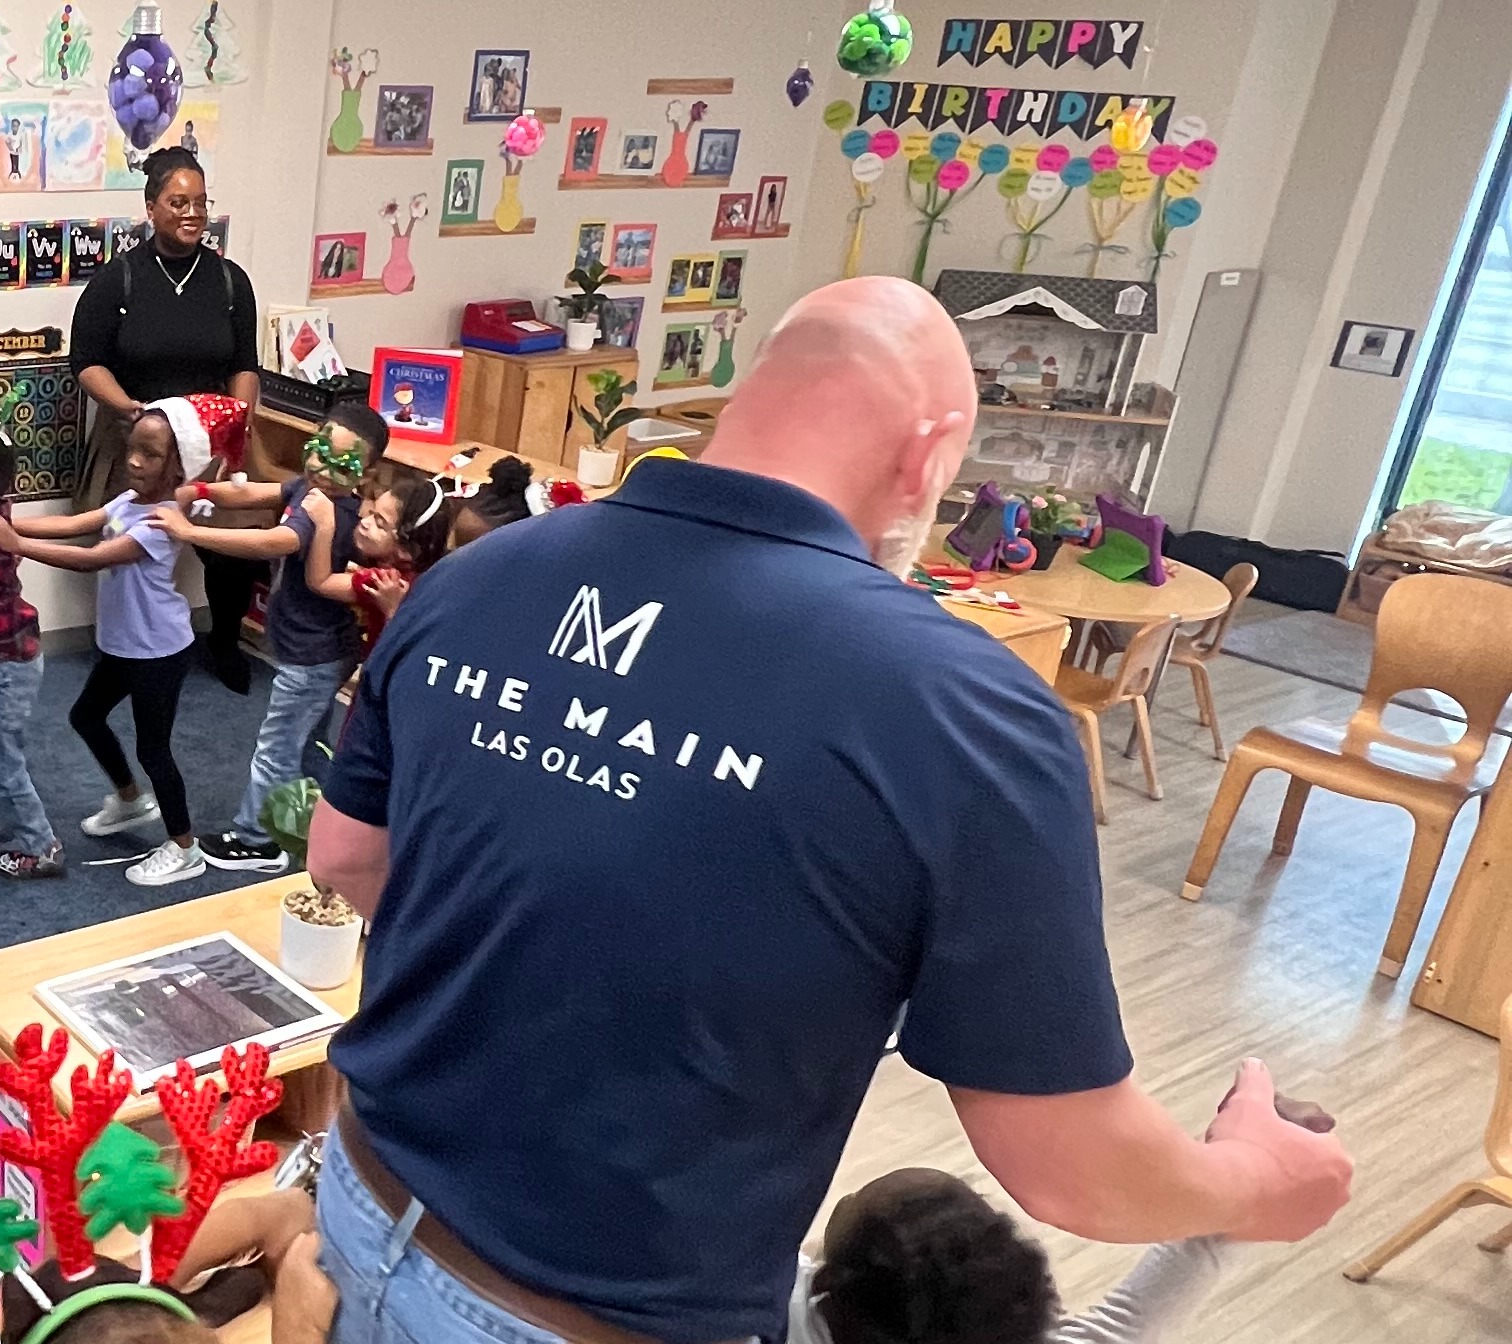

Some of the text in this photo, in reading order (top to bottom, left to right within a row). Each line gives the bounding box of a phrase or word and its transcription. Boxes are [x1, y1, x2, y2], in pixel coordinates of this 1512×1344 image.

[946, 21, 1139, 55] HAPPY
[867, 82, 1172, 129] BIRTHDAY
[31, 237, 57, 258] Vv
[74, 235, 101, 256] Ww
[389, 367, 445, 382] CHRISTMAS
[426, 655, 764, 791] THE MAIN
[470, 721, 642, 801] LAS OLAS
